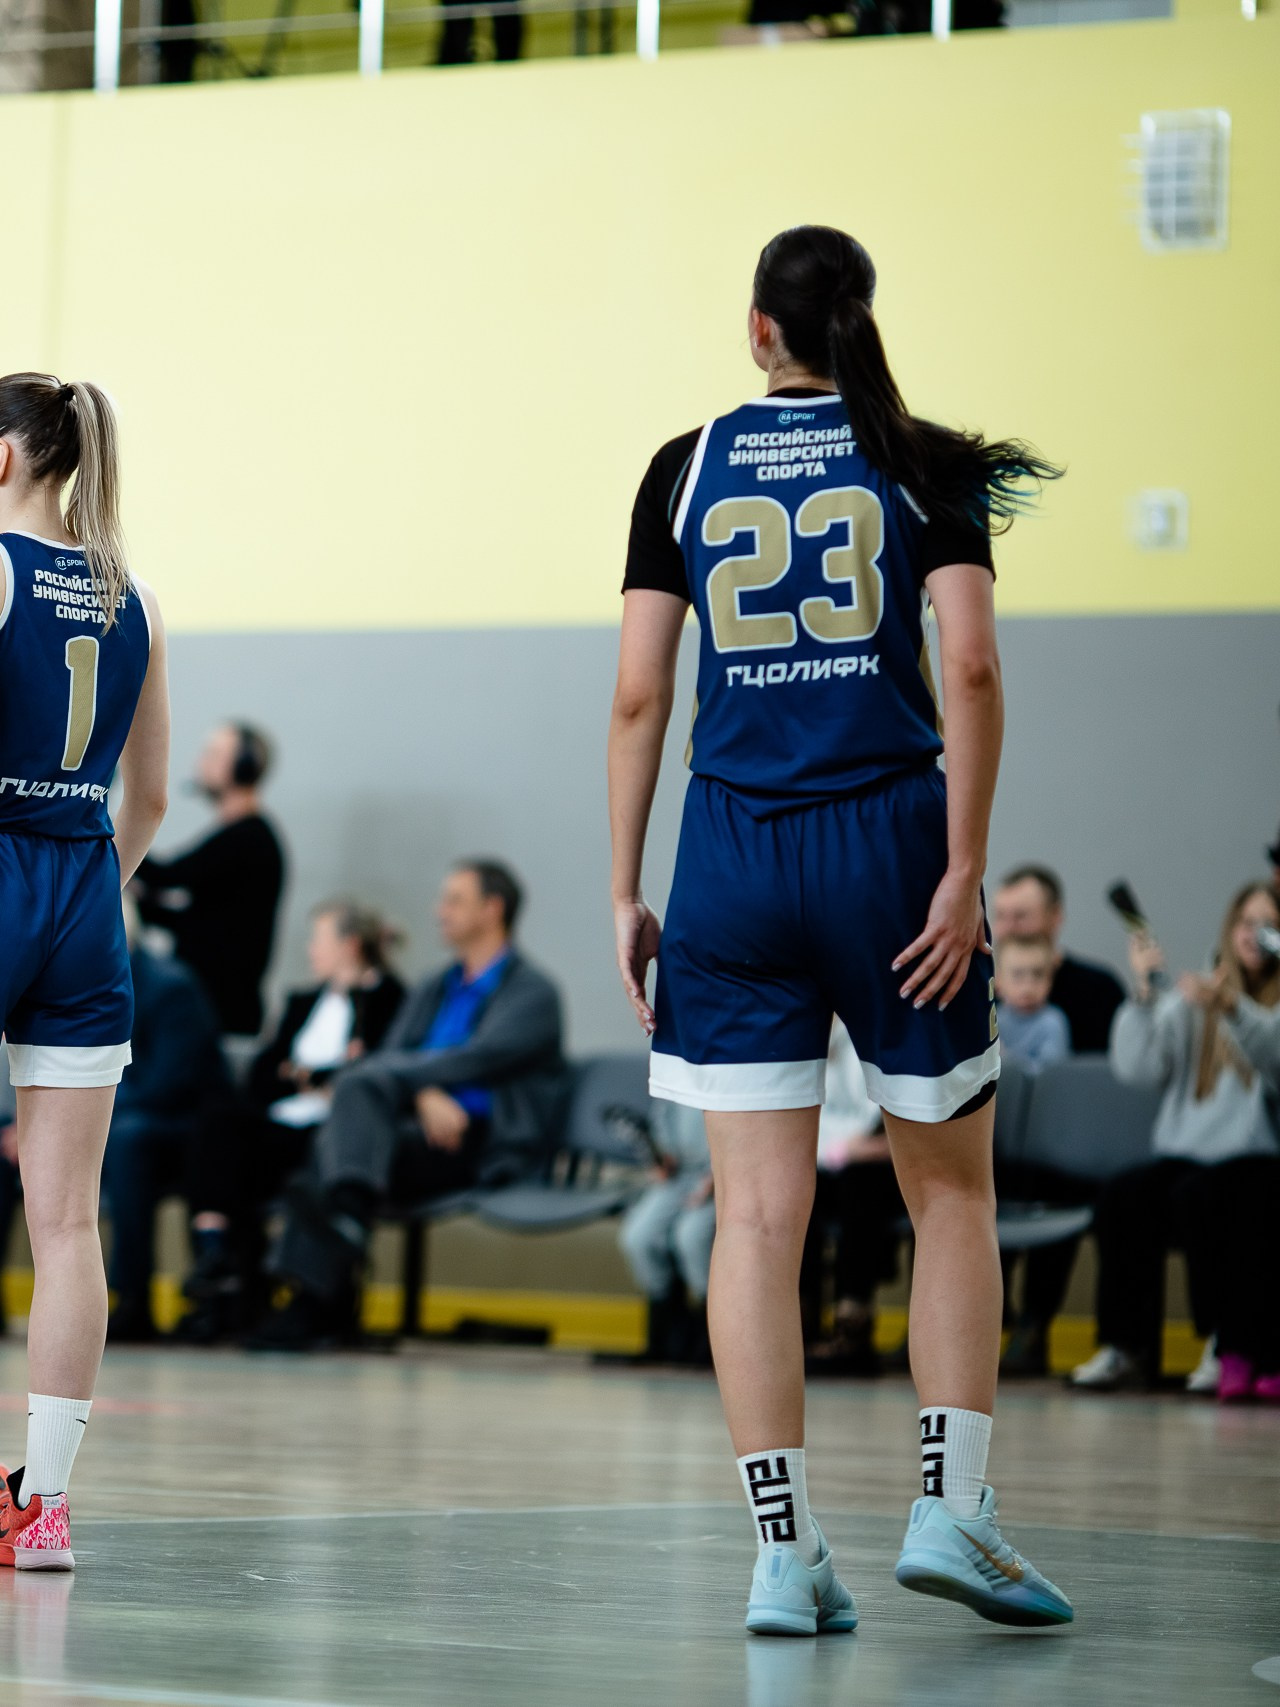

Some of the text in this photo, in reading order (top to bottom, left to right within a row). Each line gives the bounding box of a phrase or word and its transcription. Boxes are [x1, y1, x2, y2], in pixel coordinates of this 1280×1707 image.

[792, 412, 816, 420] SPORT
[734, 424, 853, 449] РОССИЙСКИЙ
[728, 441, 857, 466] УНИВЕРСИТЕТ
[756, 461, 827, 482] СПОРТА
[701, 485, 885, 654] 23
[56, 604, 107, 623] СПОРТА
[726, 655, 880, 688] ГЦОЛИФК
[60, 635, 100, 771] 1
[745, 1456, 798, 1543] ELITE
